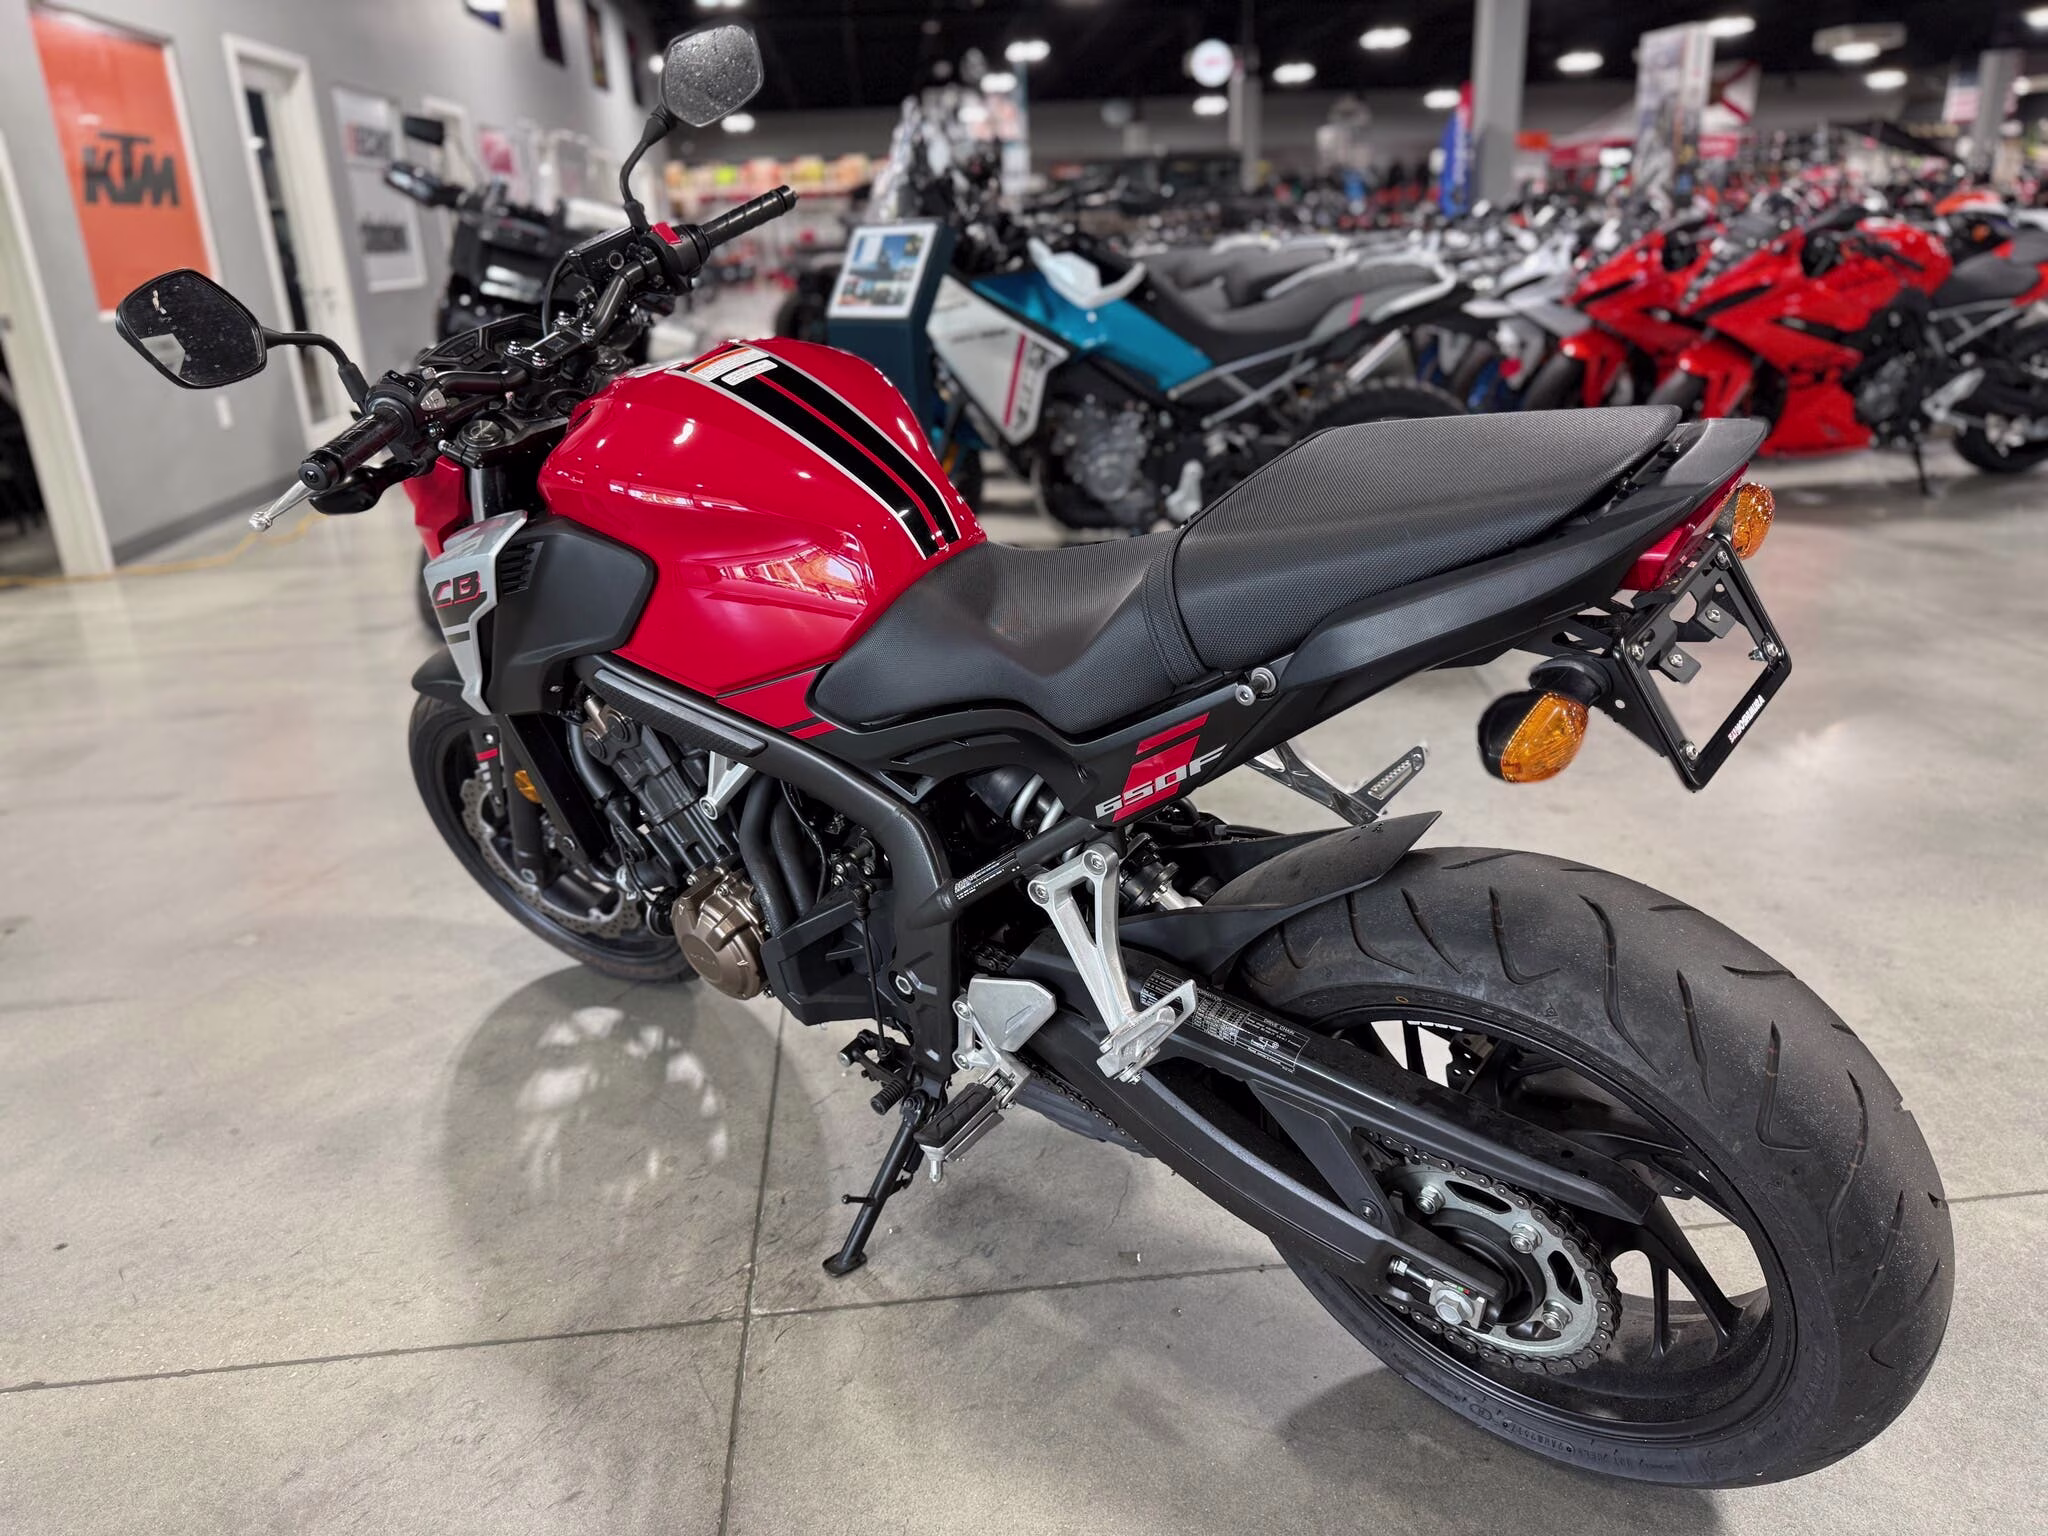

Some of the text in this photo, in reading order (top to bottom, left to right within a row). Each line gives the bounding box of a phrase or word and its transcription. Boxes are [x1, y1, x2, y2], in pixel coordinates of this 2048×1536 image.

[84, 132, 180, 206] KTM
[432, 570, 481, 608] CB
[1095, 744, 1227, 819] 650F
[1279, 1024, 1295, 1035] CHAIN
